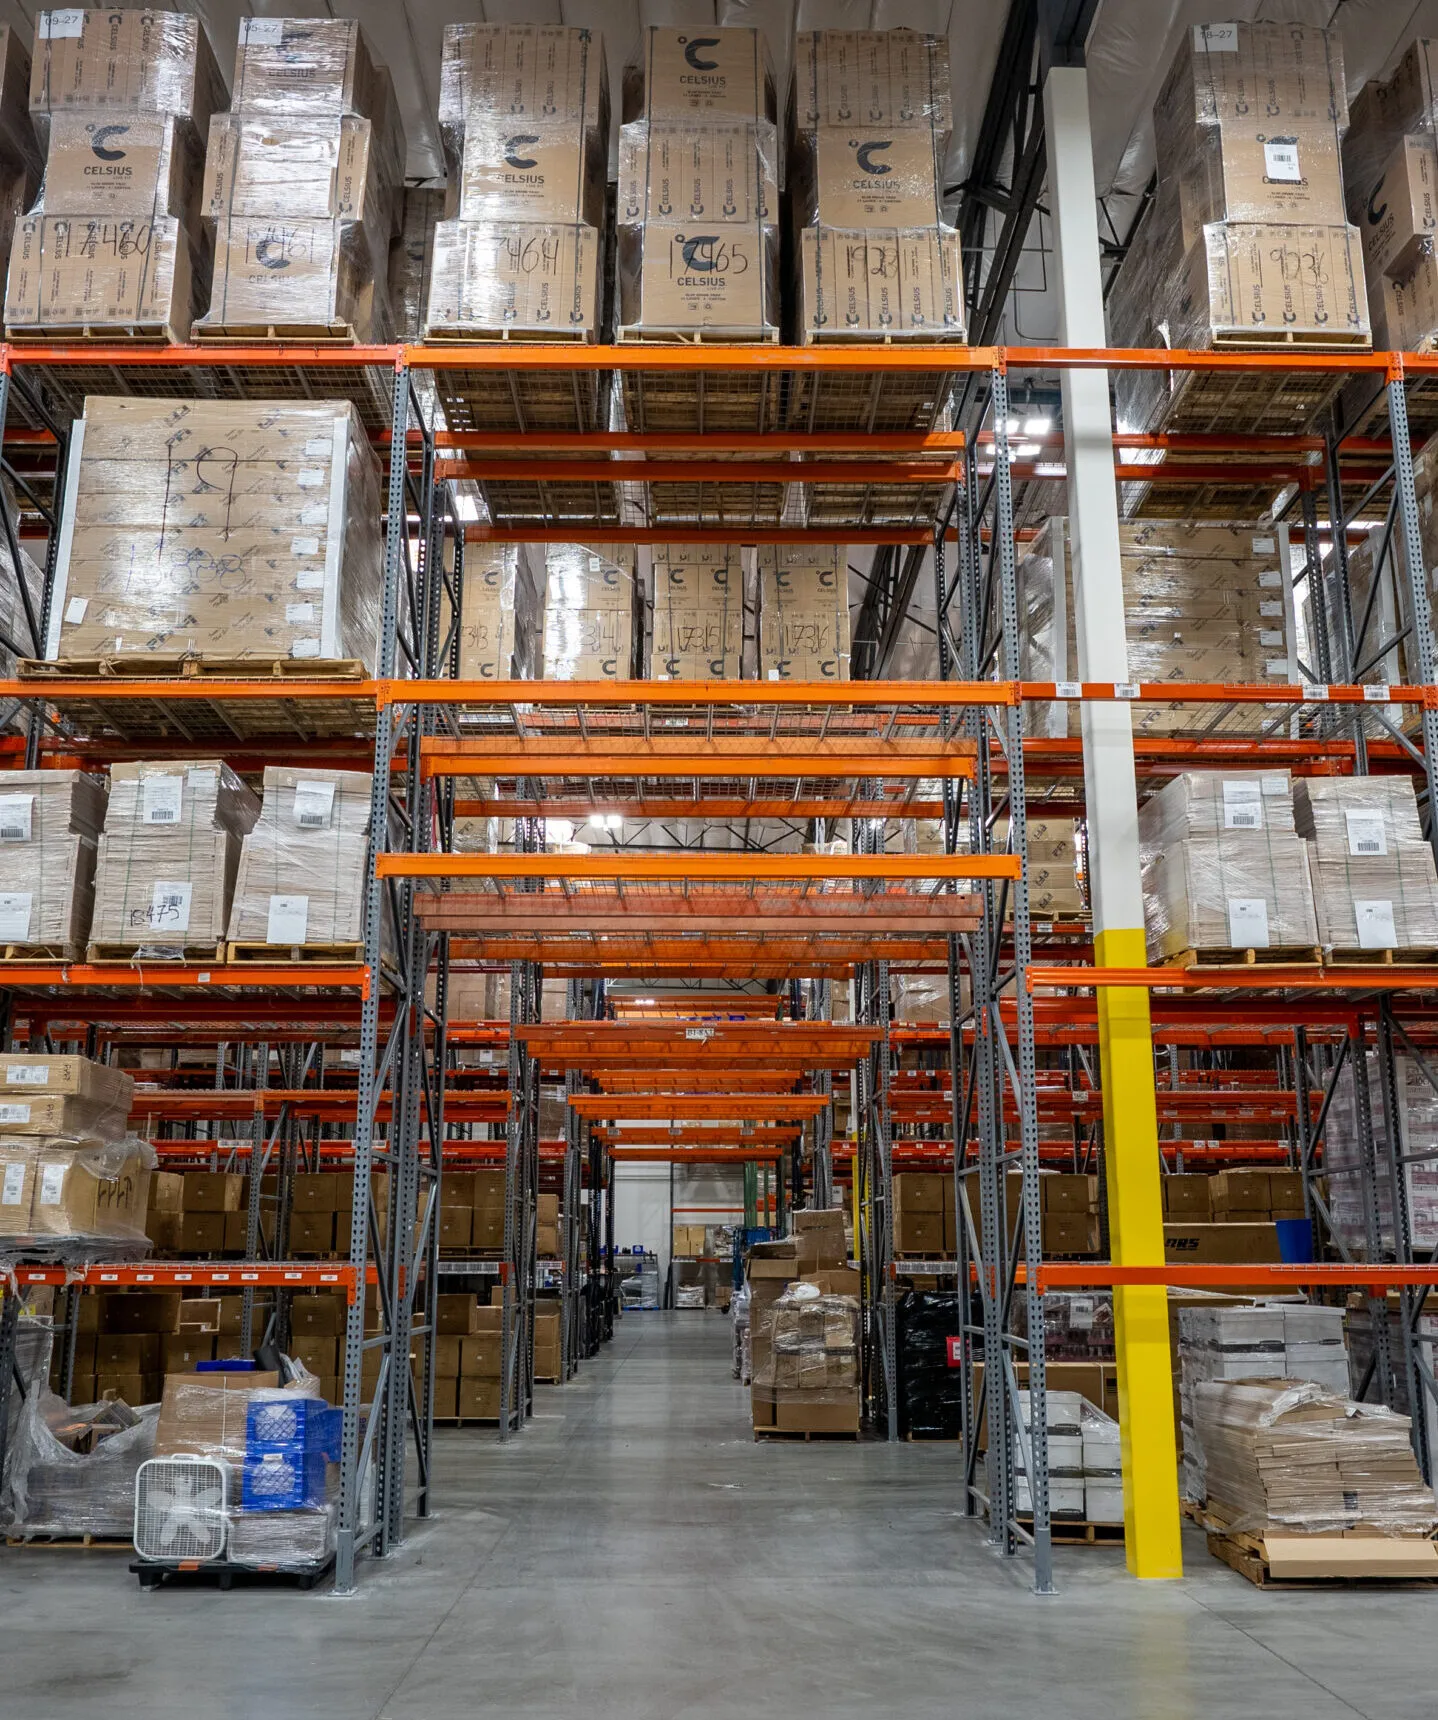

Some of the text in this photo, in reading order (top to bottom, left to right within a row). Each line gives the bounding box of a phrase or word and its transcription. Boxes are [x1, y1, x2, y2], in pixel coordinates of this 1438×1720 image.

[45, 15, 79, 26] 09-27
[110, 24, 119, 51] CELSIUS
[680, 76, 726, 85] CELSIUS
[84, 166, 132, 176] CELSIUS
[853, 180, 900, 189] CELSIUS
[215, 173, 224, 200] CELSIUS
[344, 177, 352, 203] CELSIUS
[661, 178, 669, 205] CELSIUS
[1423, 192, 1432, 218] CELSIUS
[23, 232, 32, 260] CELSIUS
[65, 223, 150, 257] 17460
[670, 240, 748, 279] 17465
[677, 277, 726, 287] CELSIUS
[541, 283, 549, 310] CELSIUS
[913, 287, 921, 314] CELSIUS
[1253, 284, 1261, 311] CELSIUS
[1284, 284, 1293, 312] CELSIUS
[159, 443, 238, 566] 19
[677, 627, 721, 651] 17315
[786, 625, 830, 649] 17316
